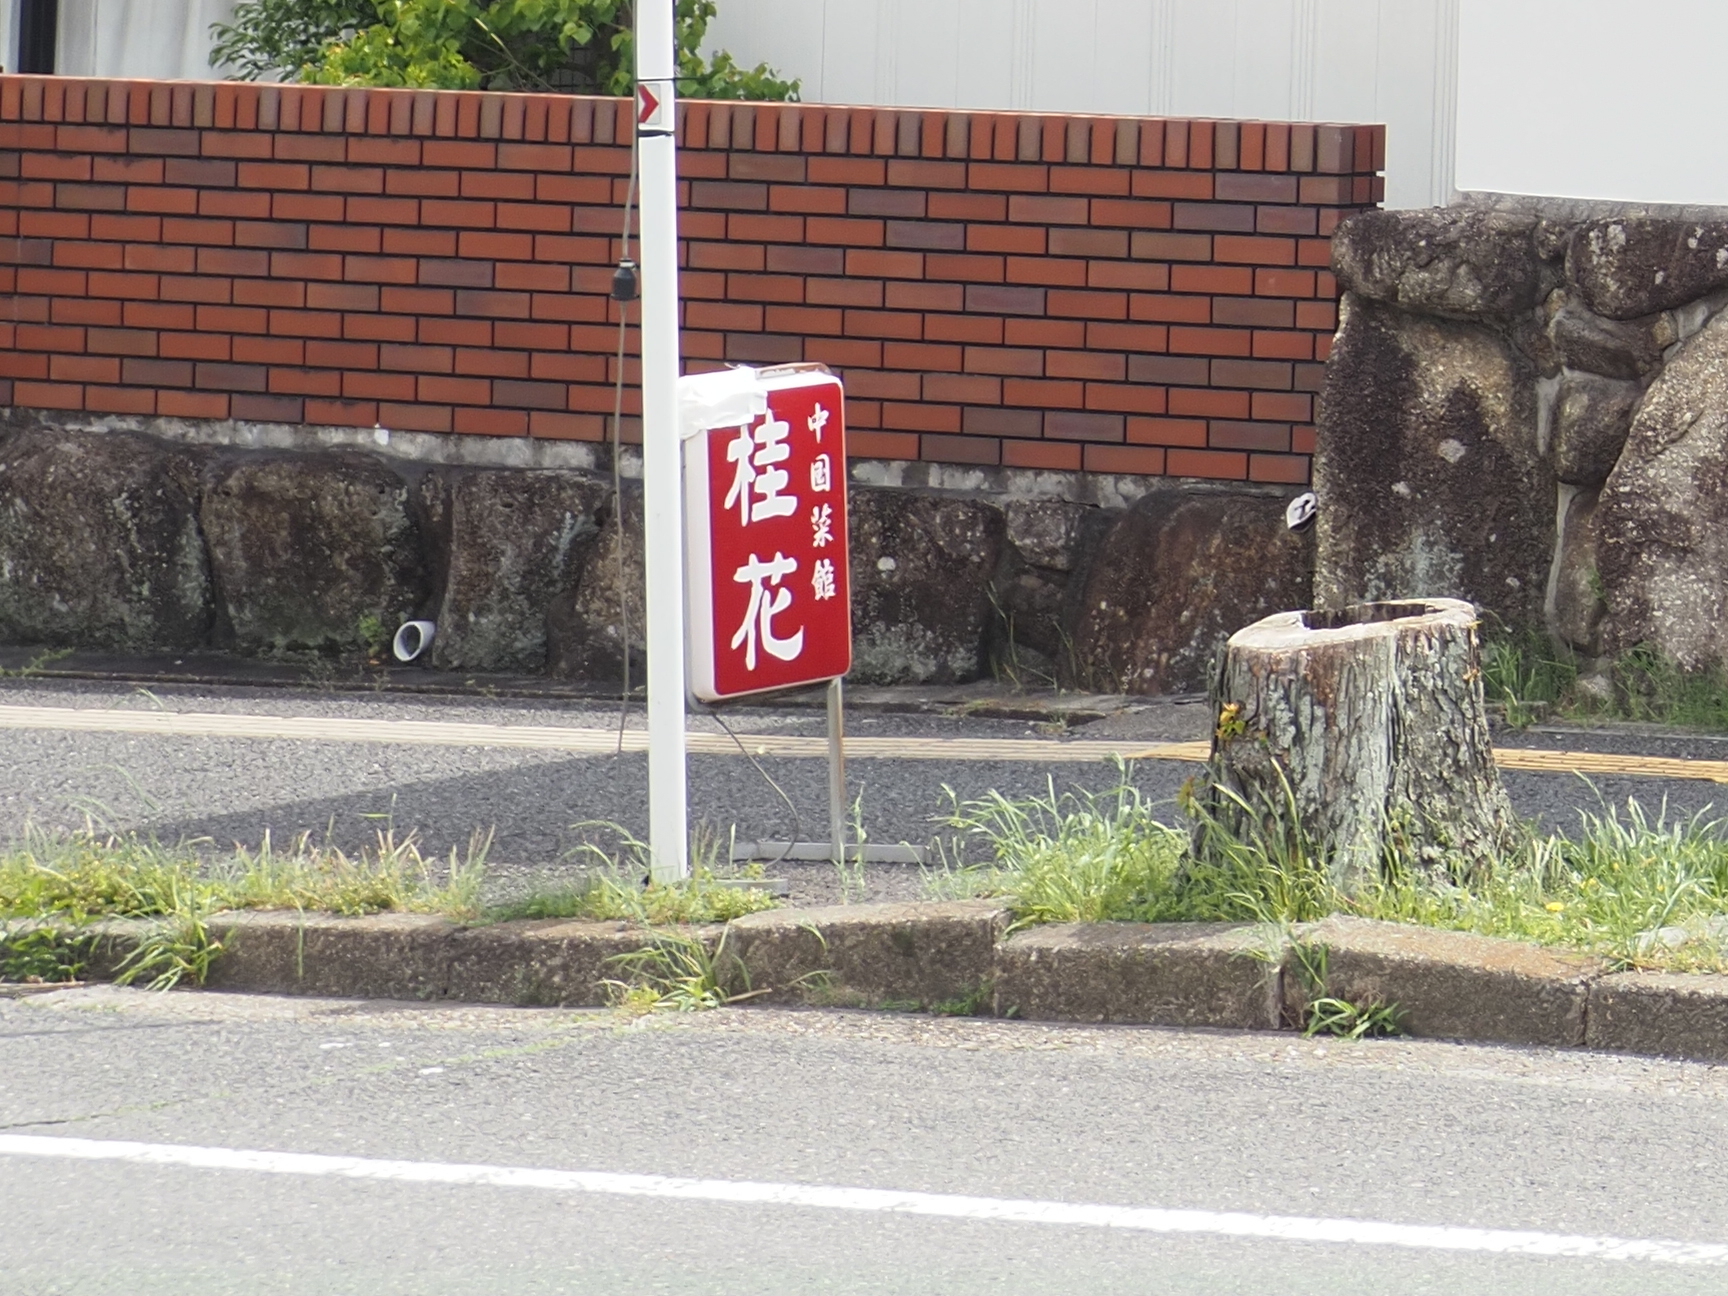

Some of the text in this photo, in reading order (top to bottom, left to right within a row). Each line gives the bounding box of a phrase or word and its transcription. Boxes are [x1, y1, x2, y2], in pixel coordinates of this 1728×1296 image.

[724, 408, 804, 671] 桂花
[807, 402, 836, 601] 中国菜館
